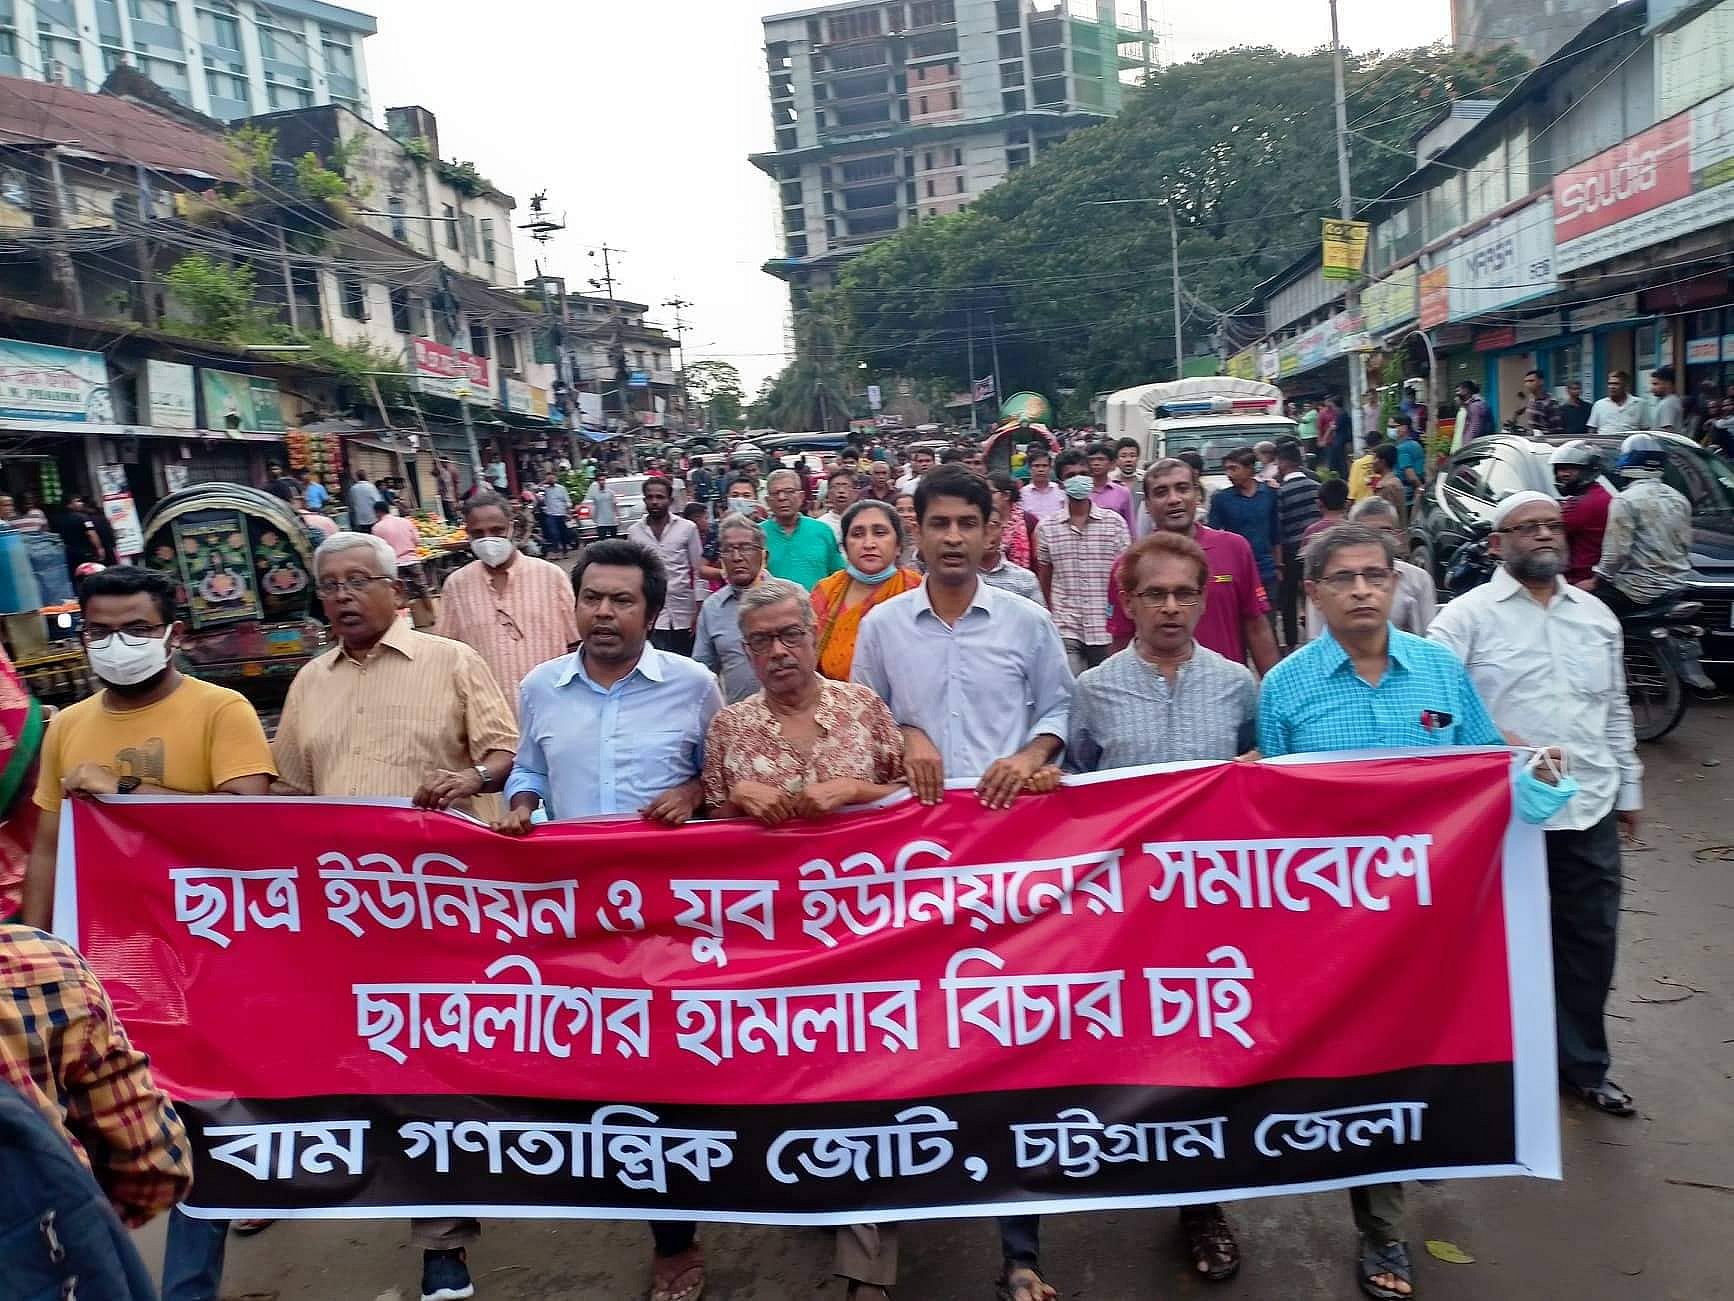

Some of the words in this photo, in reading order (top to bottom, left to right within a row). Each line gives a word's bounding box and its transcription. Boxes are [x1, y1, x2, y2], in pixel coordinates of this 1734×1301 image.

[169, 867, 300, 948] ছাত্র
[318, 852, 578, 943] ইউনিয়ন
[597, 880, 643, 929] ও
[670, 880, 779, 967] যুব
[799, 840, 1123, 948] ইউনিয়নের
[1143, 834, 1433, 911] সমাবেশে
[352, 955, 652, 1064] ছাত্রলীগের
[672, 980, 920, 1065] হামলার
[940, 948, 1124, 1048] বিচার
[1143, 946, 1254, 1048] চাই
[203, 1120, 370, 1180] বাম
[398, 1105, 736, 1192] গণতান্ত্রিক
[767, 1106, 987, 1183] জোট,
[1010, 1108, 1227, 1177] চট্টগ্রাম
[1255, 1102, 1427, 1156] জেলা
